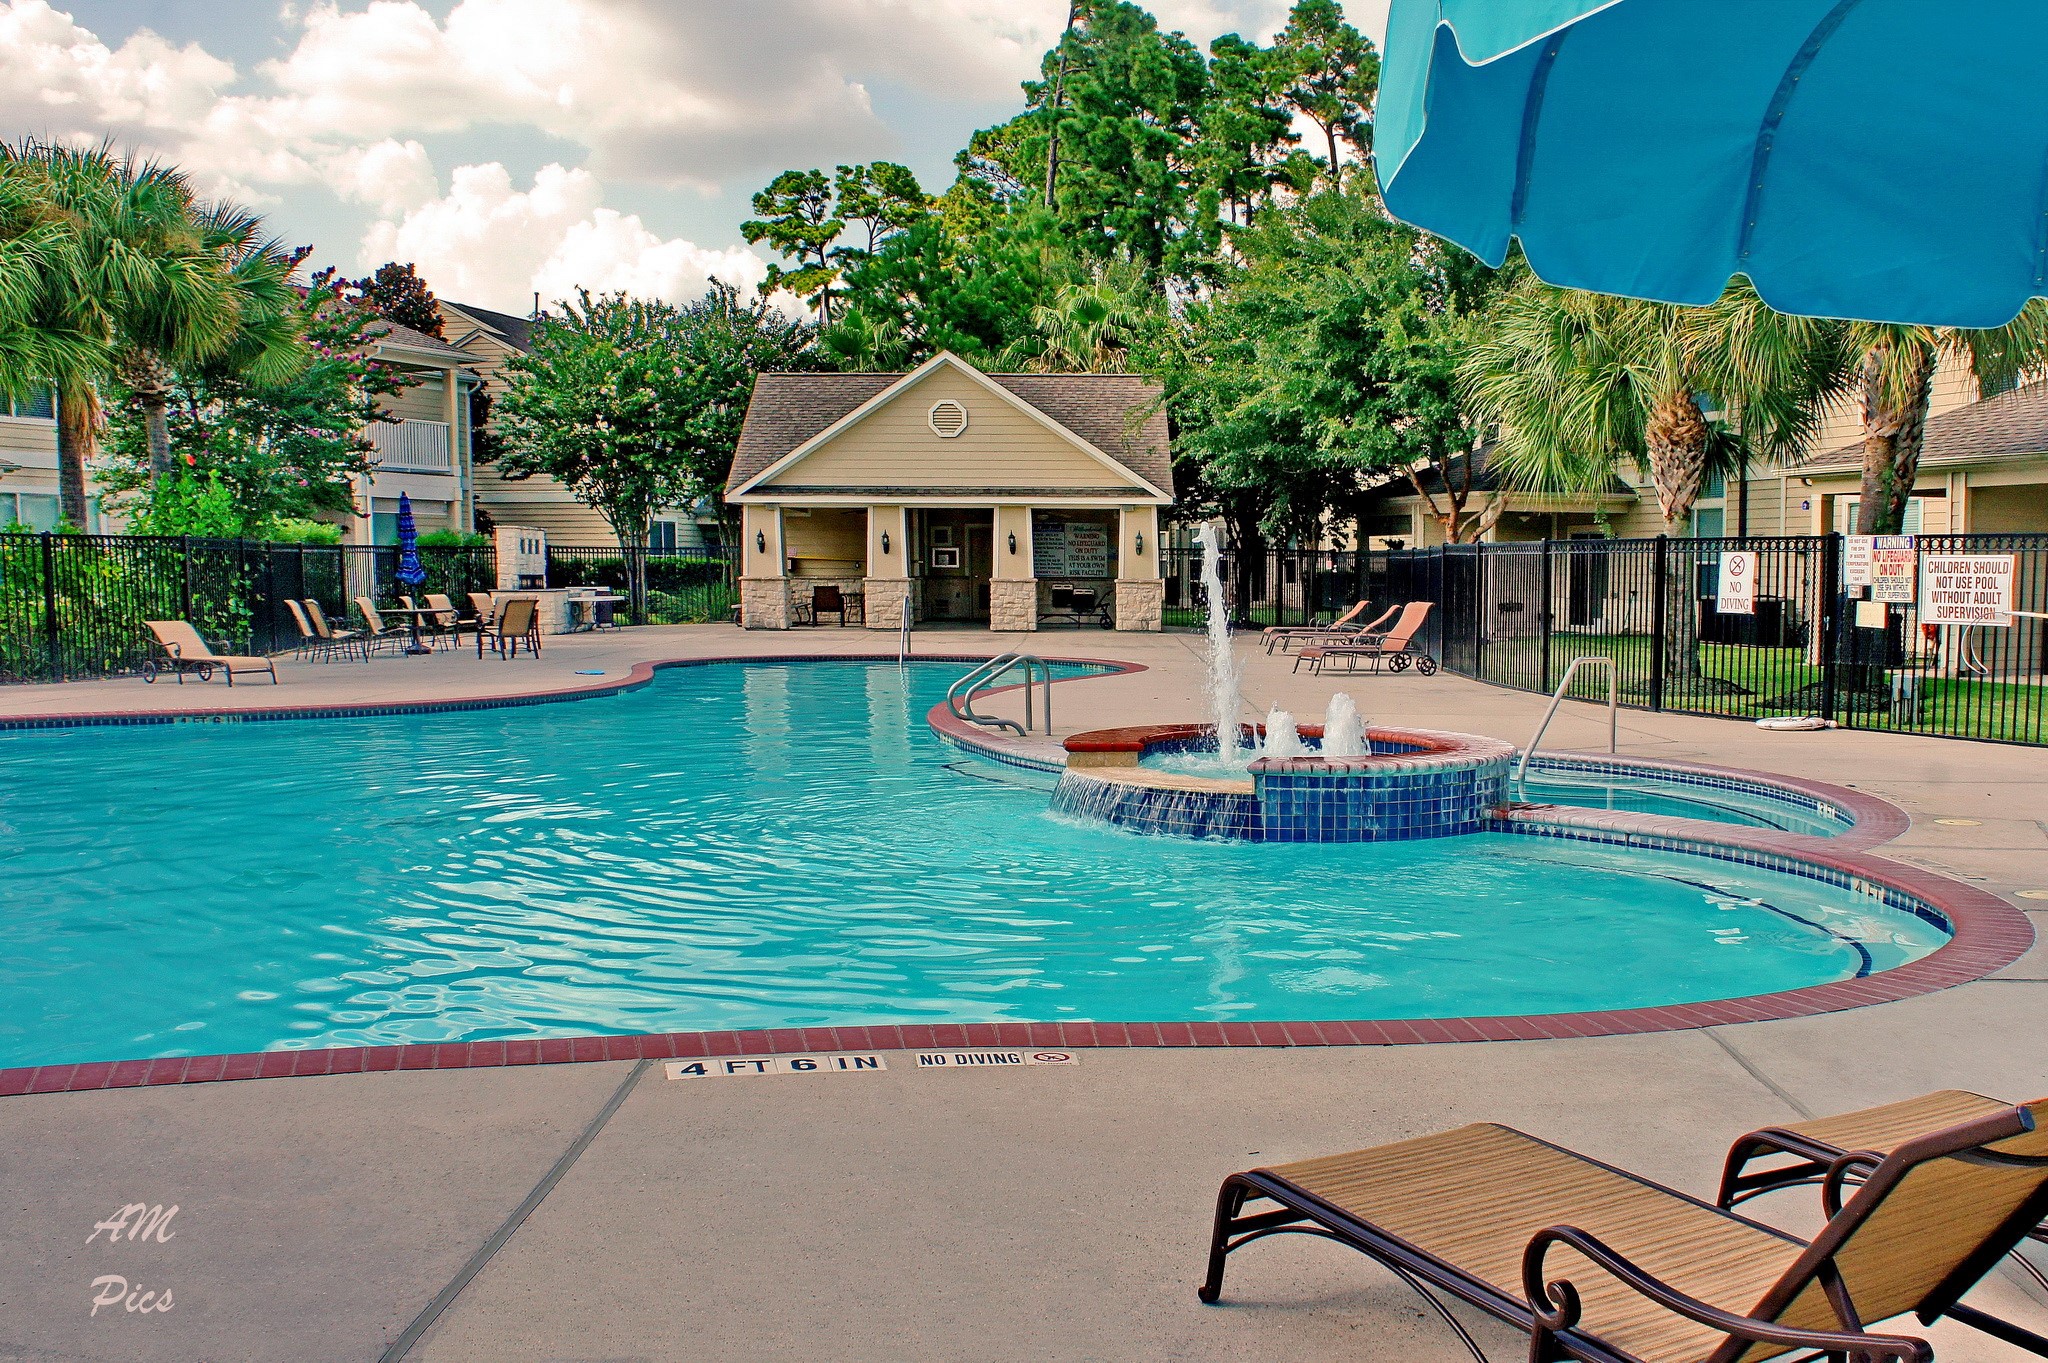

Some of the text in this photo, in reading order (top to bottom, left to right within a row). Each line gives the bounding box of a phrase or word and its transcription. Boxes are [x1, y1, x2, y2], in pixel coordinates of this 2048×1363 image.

[1876, 536, 1910, 548] WARNING
[1873, 551, 1912, 562] NO LIFEGUARD
[1880, 564, 1904, 576] ON DUTY
[1928, 561, 2008, 574] CHILDREN SHOULD
[1730, 582, 1742, 593] NO
[1936, 576, 1998, 589] NOT USE POOL
[1721, 598, 1748, 610] DIVING
[1932, 591, 2002, 604] WITHOUT ADULT
[1937, 606, 1996, 620] SUPERVISION
[1856, 880, 1881, 900] 4 FT
[681, 1056, 879, 1076] 4 FT 6 IN
[919, 1053, 1020, 1066] NO DIVING
